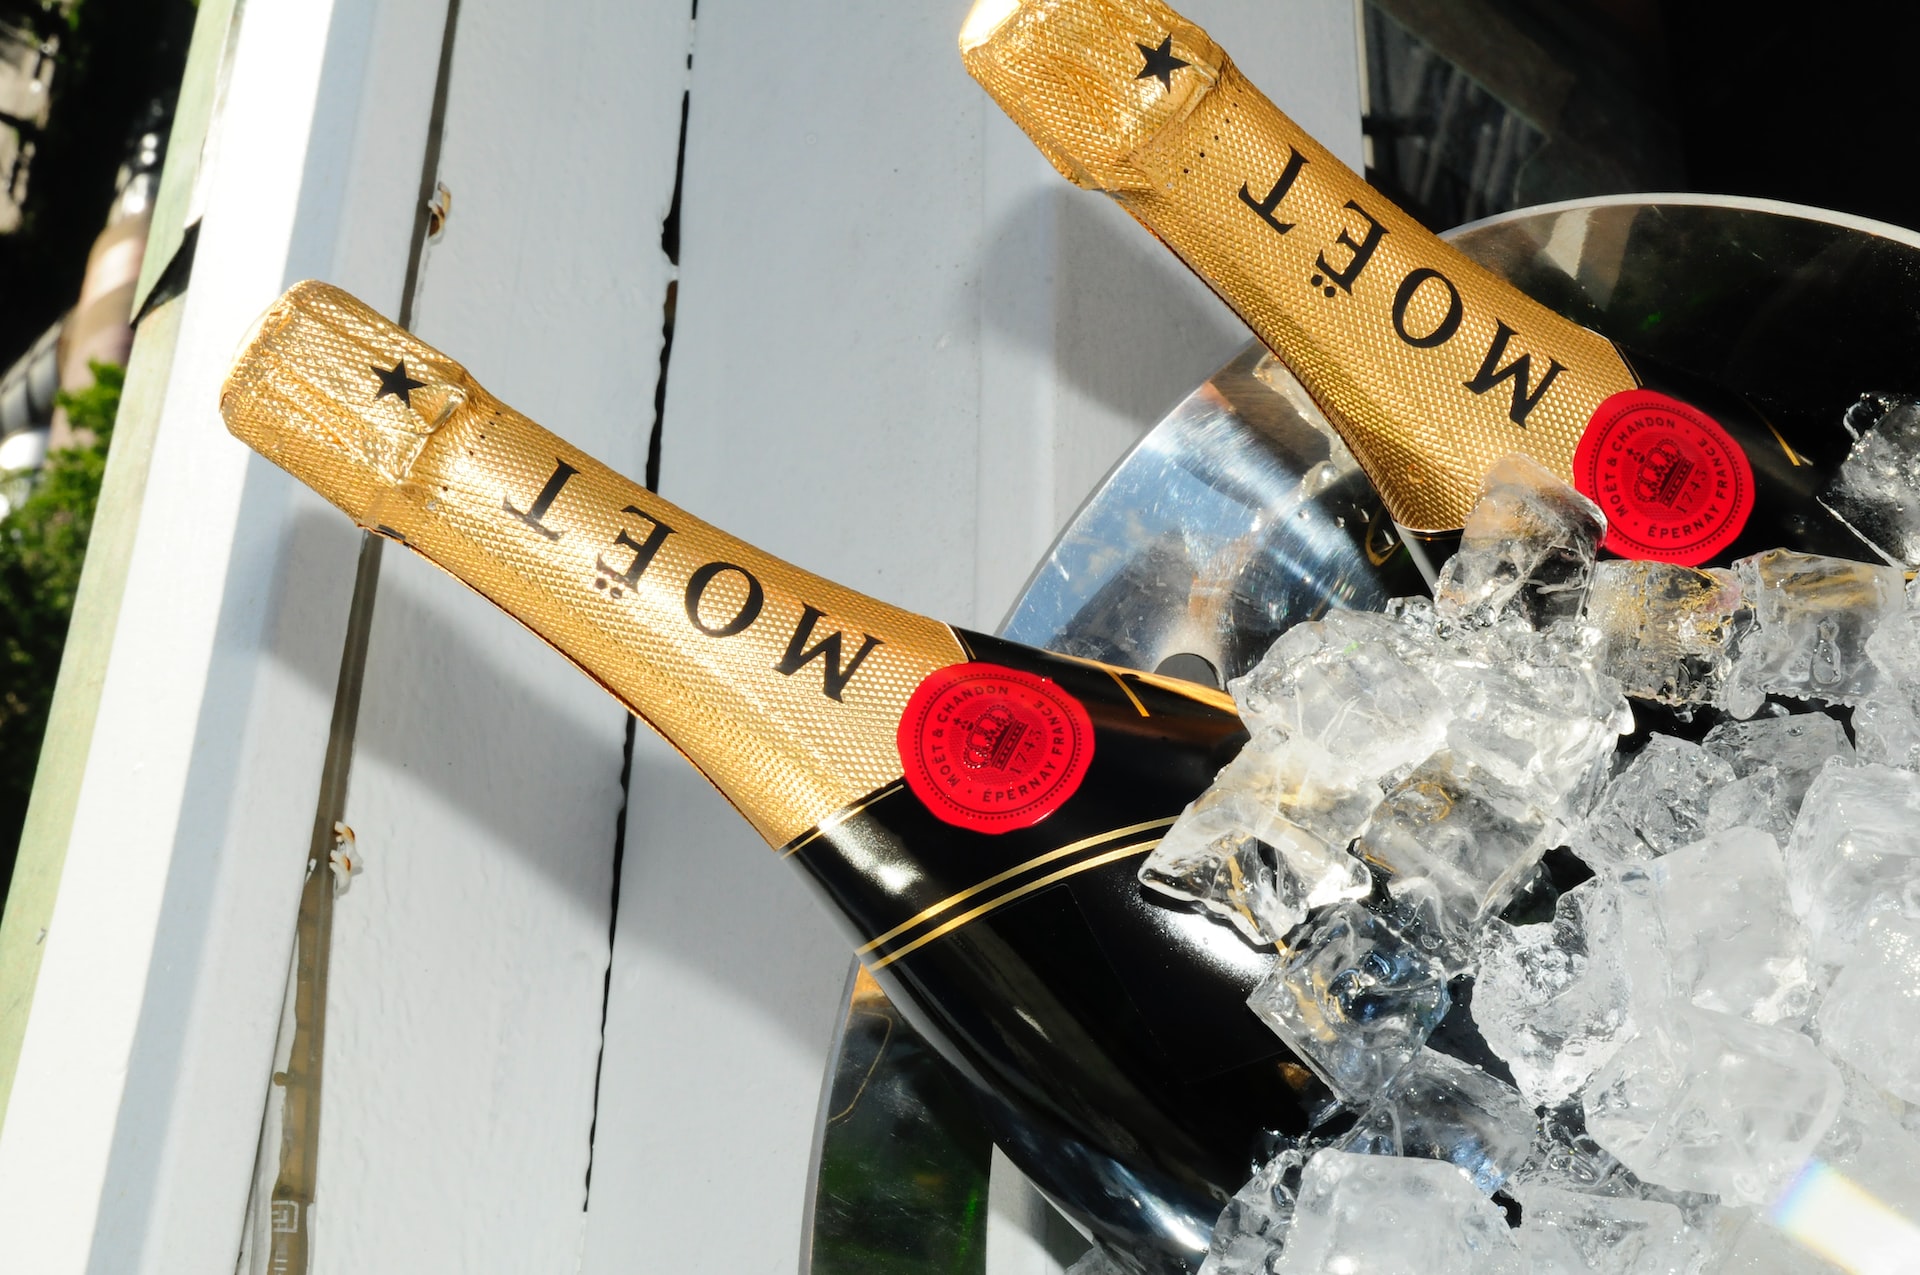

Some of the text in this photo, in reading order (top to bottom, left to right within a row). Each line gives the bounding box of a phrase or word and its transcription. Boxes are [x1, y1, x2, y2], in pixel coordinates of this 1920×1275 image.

[1238, 145, 1568, 429] MOËT
[1604, 417, 1676, 518] MOËT & CHANDON
[1648, 437, 1728, 540] ÉPERNAY FRANCE
[1676, 471, 1707, 514] 1743
[505, 457, 883, 702] MOËT
[932, 686, 1009, 788] MOËT & CHANDON
[983, 700, 1064, 803] ÉPERNAY FRANCE
[1010, 729, 1042, 775] 1743
